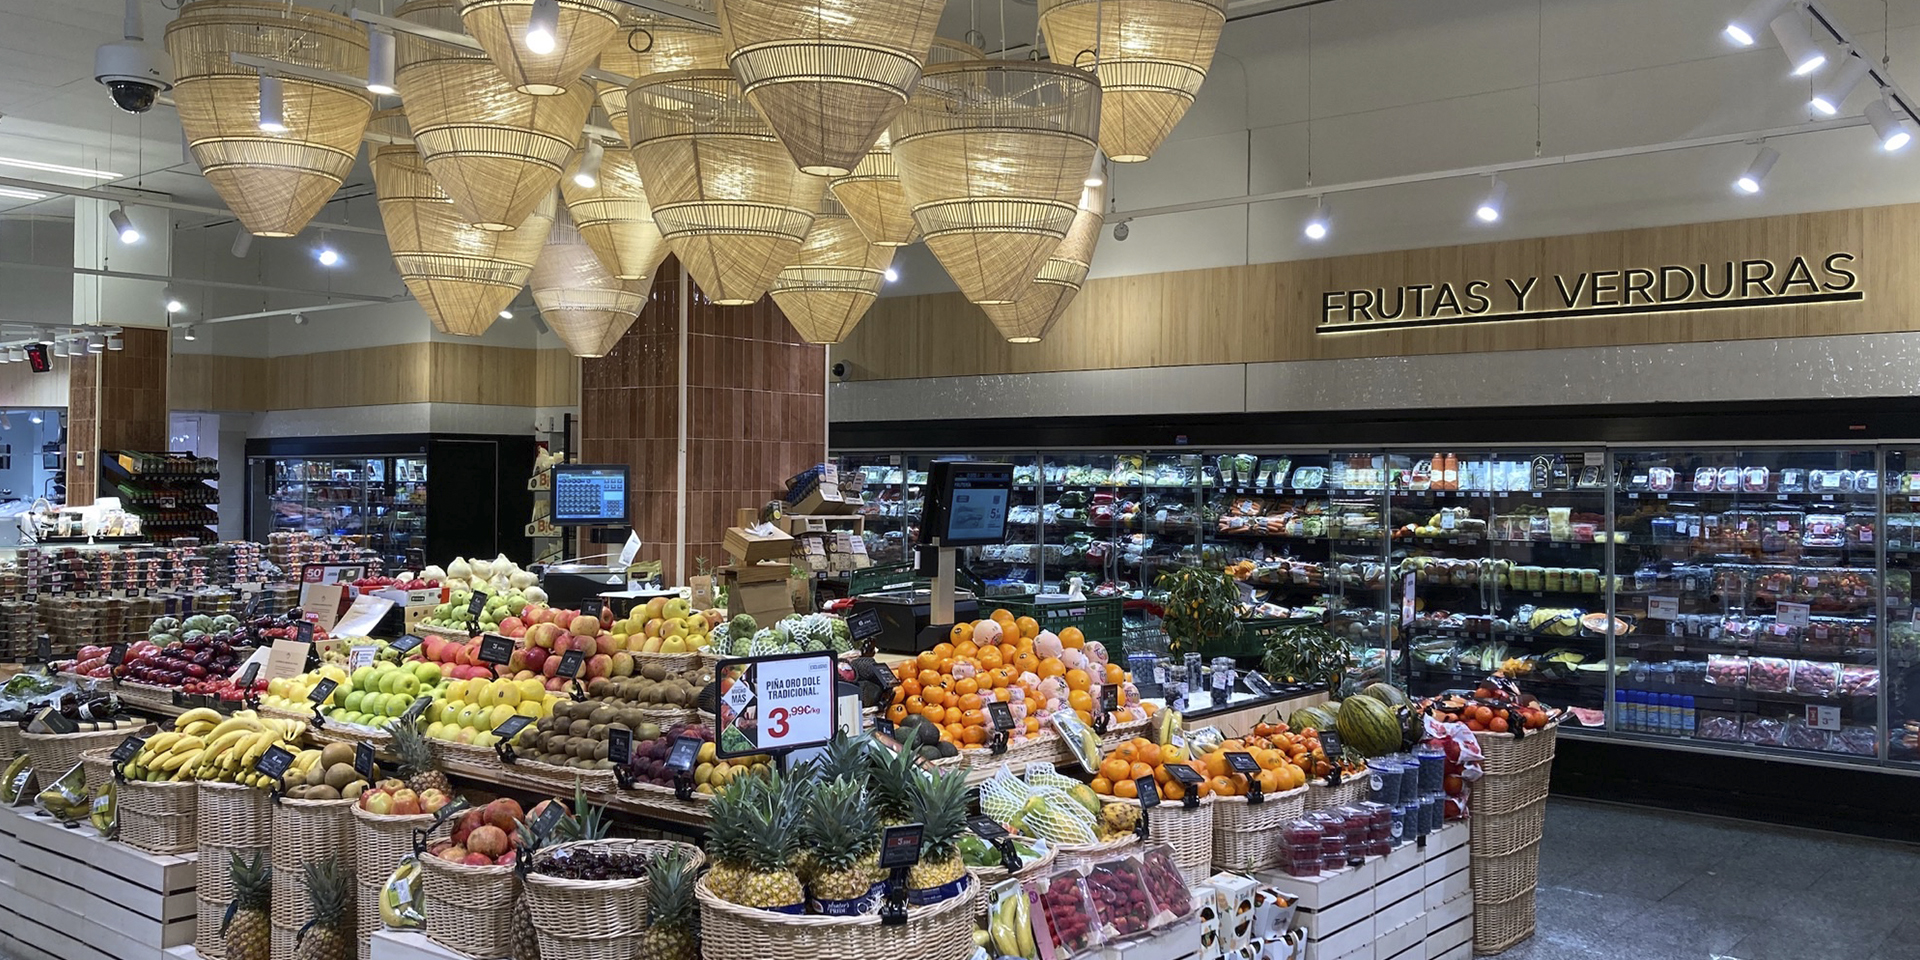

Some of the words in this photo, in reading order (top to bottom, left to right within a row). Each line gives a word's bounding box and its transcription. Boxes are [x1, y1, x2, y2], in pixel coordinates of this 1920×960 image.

[1321, 280, 1491, 323] FRUTAS
[1504, 276, 1538, 312] Y
[1553, 252, 1856, 309] VERDURAS
[766, 677, 785, 691] PIÑA
[785, 677, 801, 688] ORO
[802, 675, 821, 687] DOLE
